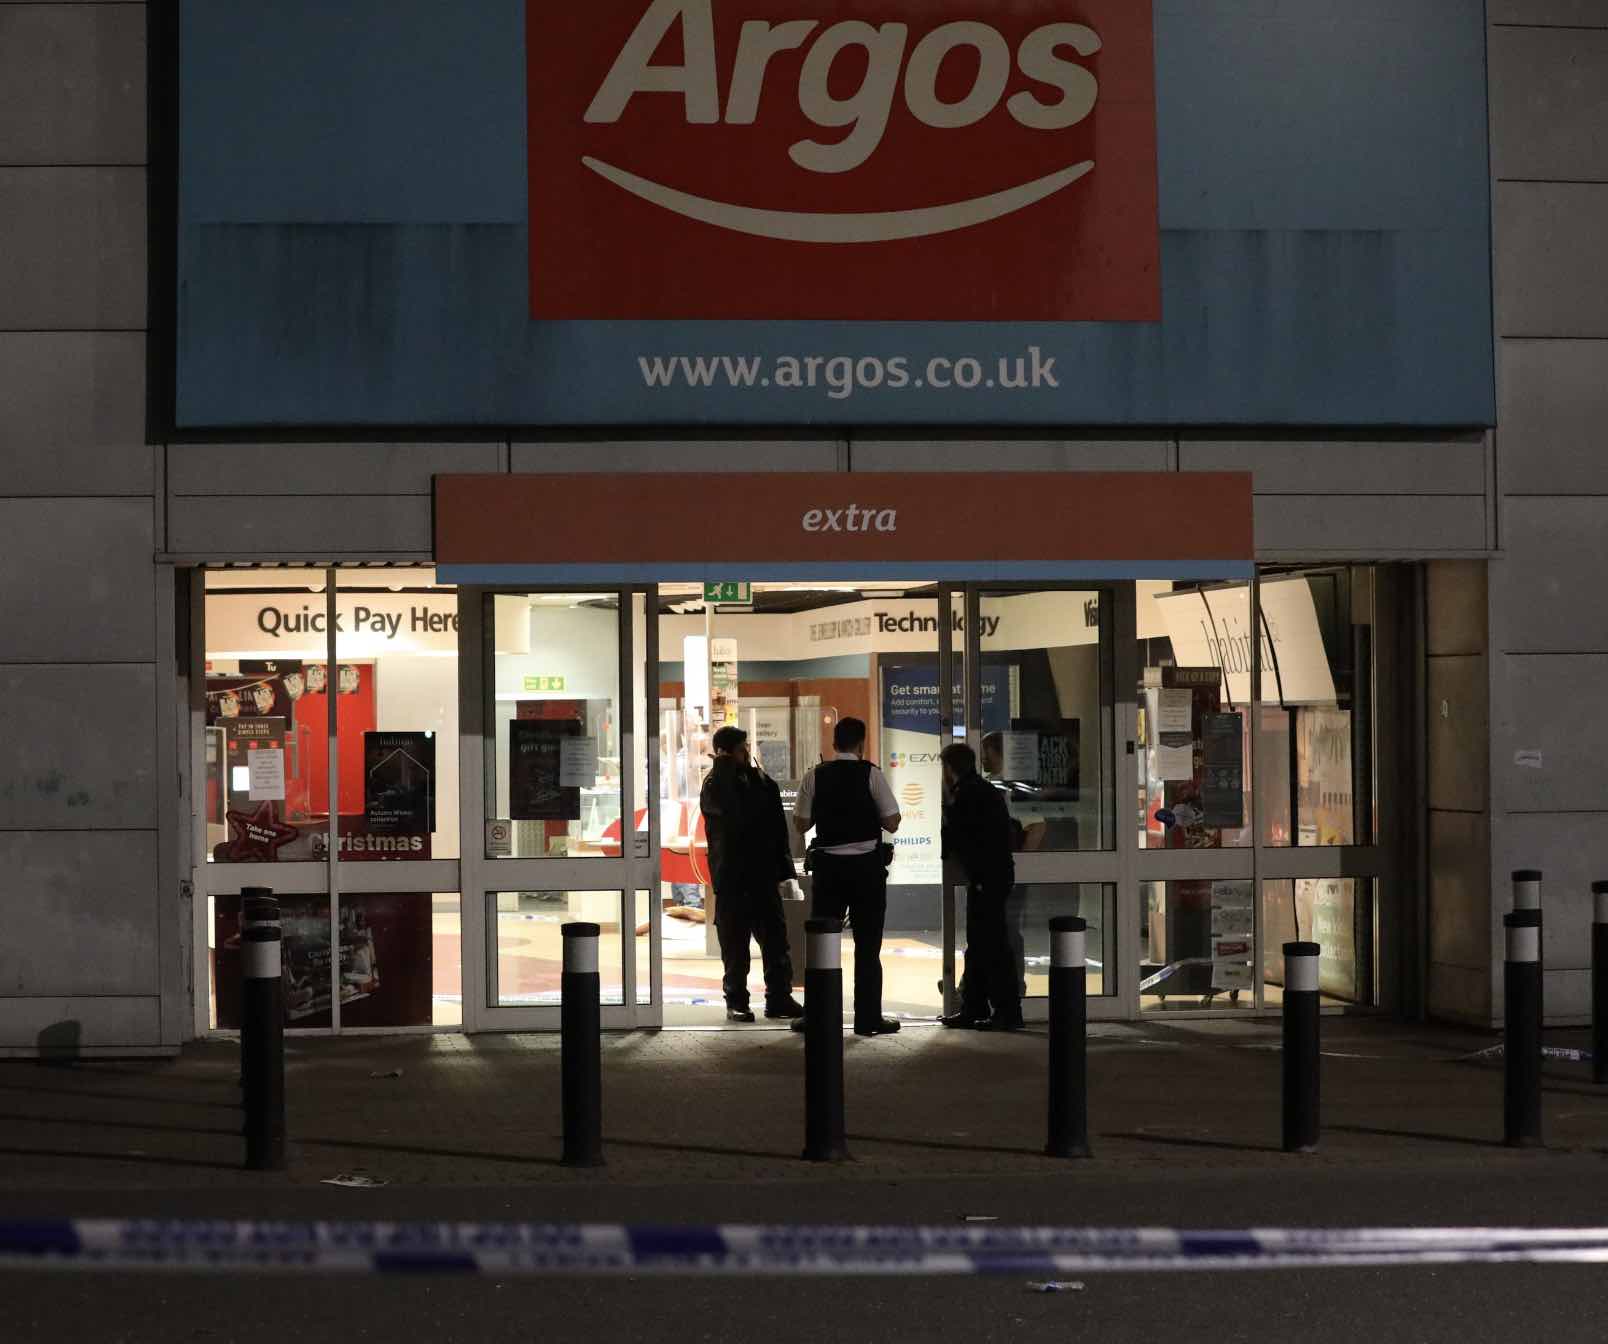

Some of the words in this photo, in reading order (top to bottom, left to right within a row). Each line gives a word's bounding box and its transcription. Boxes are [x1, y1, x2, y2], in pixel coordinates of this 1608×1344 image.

[583, 0, 1102, 174] Argos
[637, 346, 1059, 398] www.argos.co.uk
[801, 503, 897, 533] extra
[353, 606, 402, 639] Pay
[874, 610, 1000, 637] Technlogy
[1200, 616, 1274, 674] habitt
[265, 661, 277, 672] Tu
[890, 684, 912, 695] Get
[913, 685, 941, 695] smar
[246, 823, 263, 834] Take
[893, 836, 932, 846] PHILIPS
